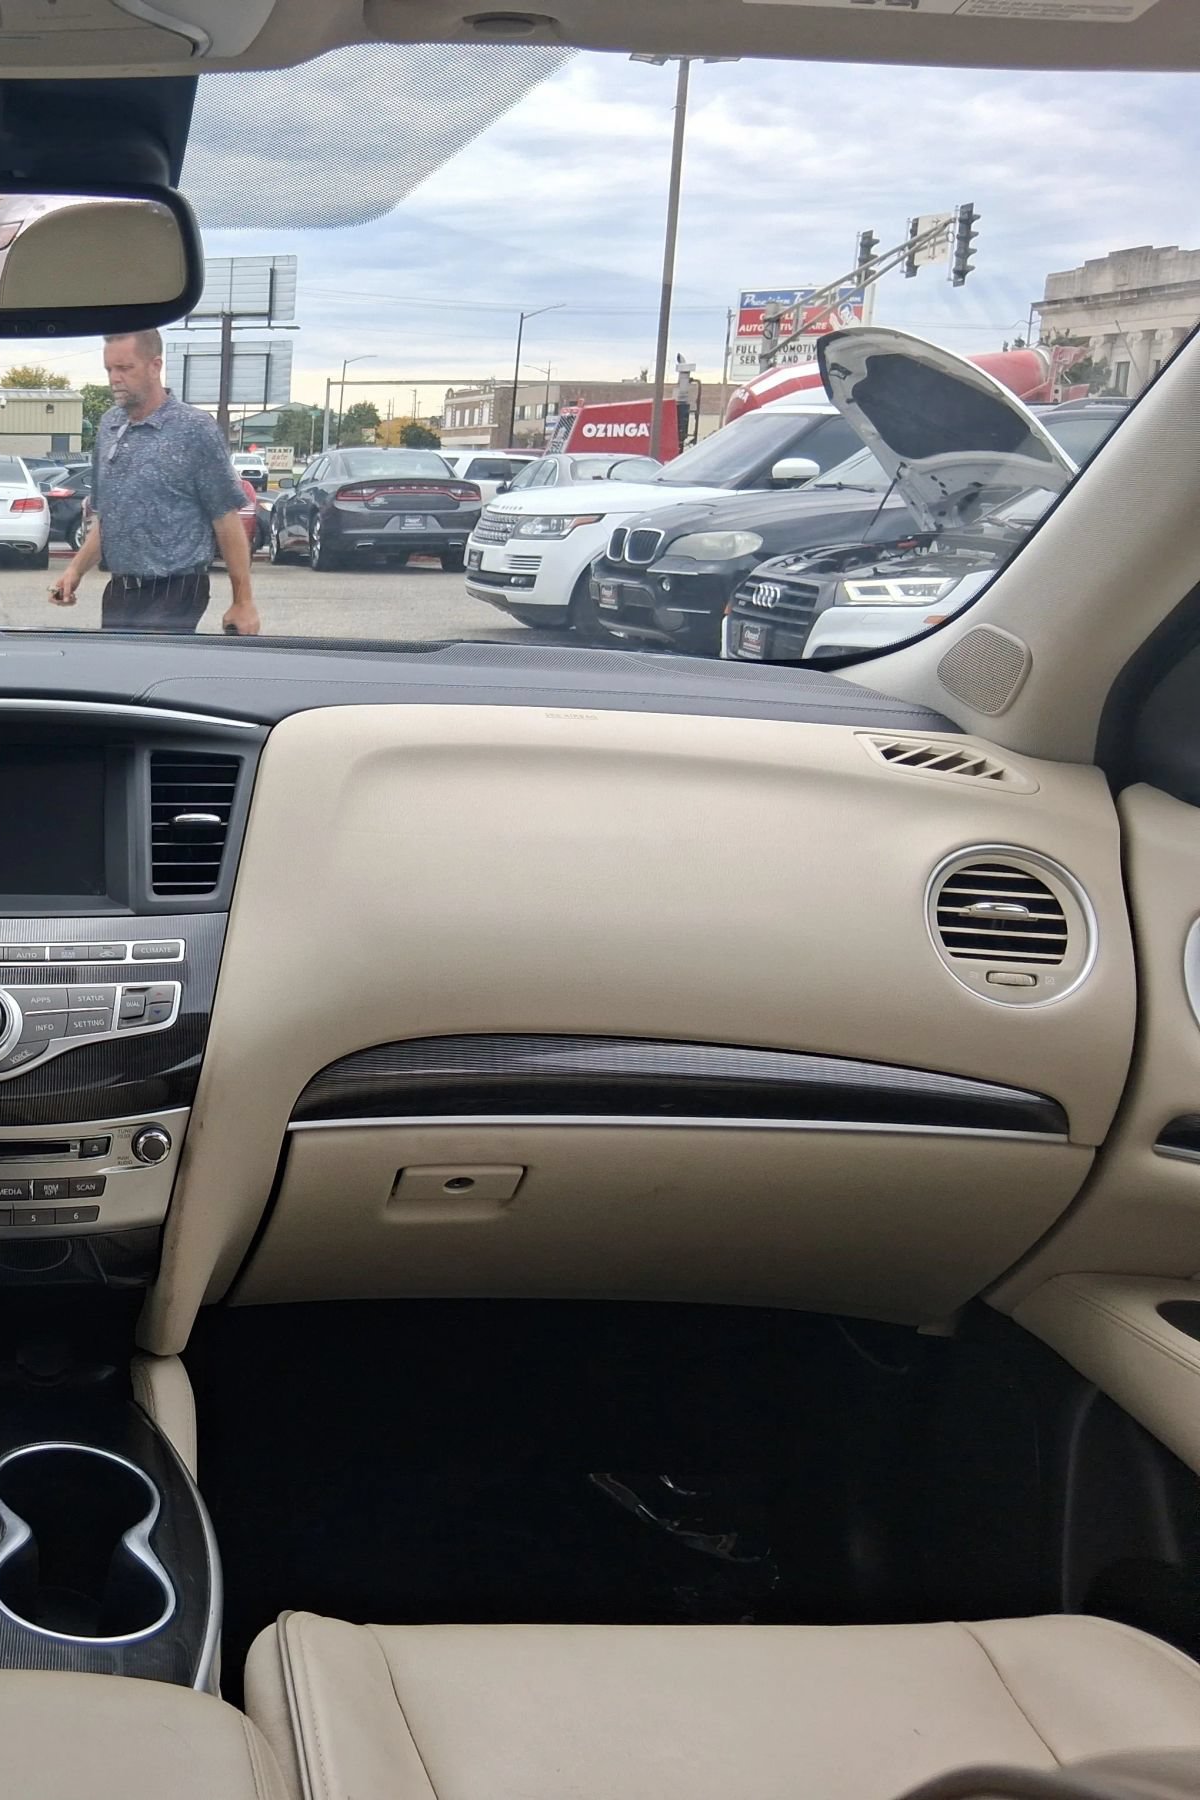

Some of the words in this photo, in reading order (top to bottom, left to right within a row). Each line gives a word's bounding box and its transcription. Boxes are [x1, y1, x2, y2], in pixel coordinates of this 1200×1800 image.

[736, 345, 757, 353] FULL
[582, 423, 650, 437] OZINGA
[73, 1020, 105, 1028] SETTING
[31, 1214, 37, 1222] 5
[73, 1212, 79, 1220] 6
